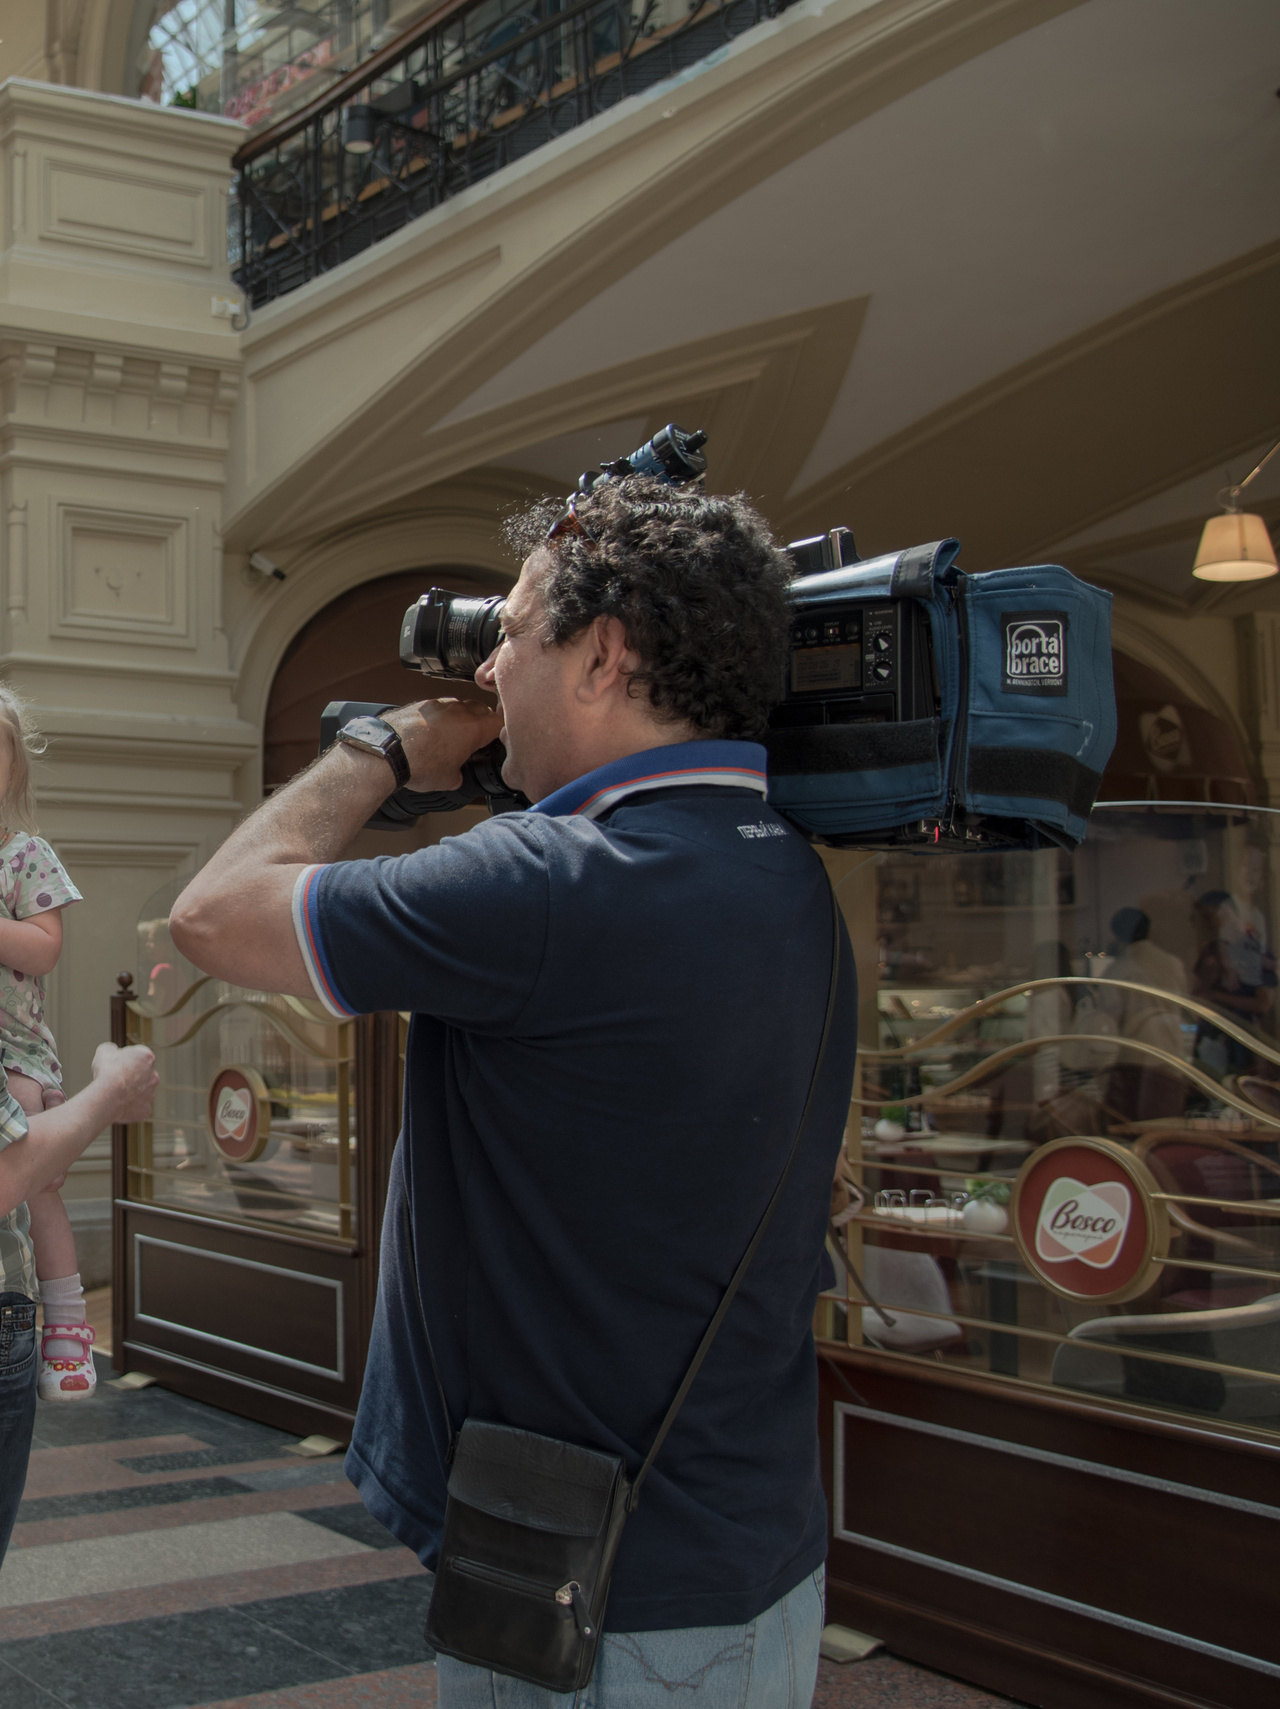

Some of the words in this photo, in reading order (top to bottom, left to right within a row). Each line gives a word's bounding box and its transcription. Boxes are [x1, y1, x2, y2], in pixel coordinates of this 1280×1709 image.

[1011, 631, 1059, 655] porta
[1011, 655, 1060, 674] brace
[221, 1099, 246, 1121] Bosco
[1050, 1198, 1116, 1234] Bosco
